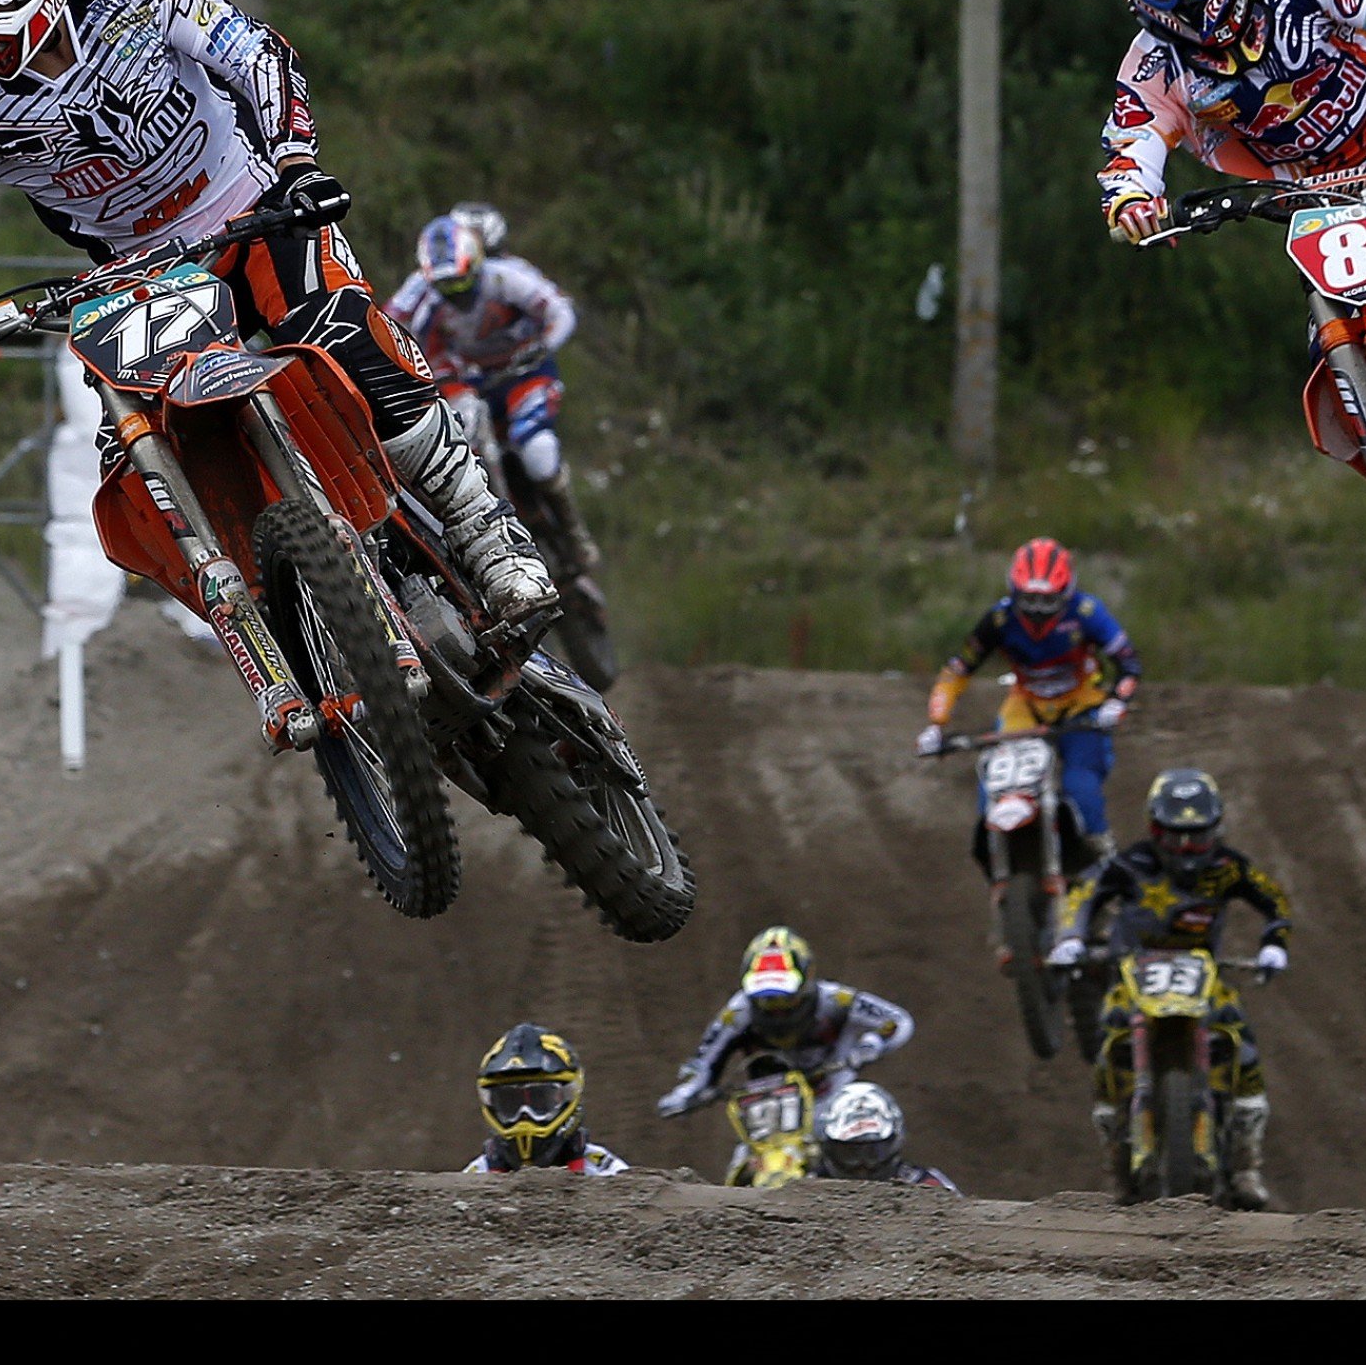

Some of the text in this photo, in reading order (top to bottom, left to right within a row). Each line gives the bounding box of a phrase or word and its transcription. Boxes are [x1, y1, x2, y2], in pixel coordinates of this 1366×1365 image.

[1248, 117, 1327, 163] Red
[97, 283, 220, 373] 17
[209, 605, 268, 697] BRAKING
[1141, 956, 1206, 996] 33
